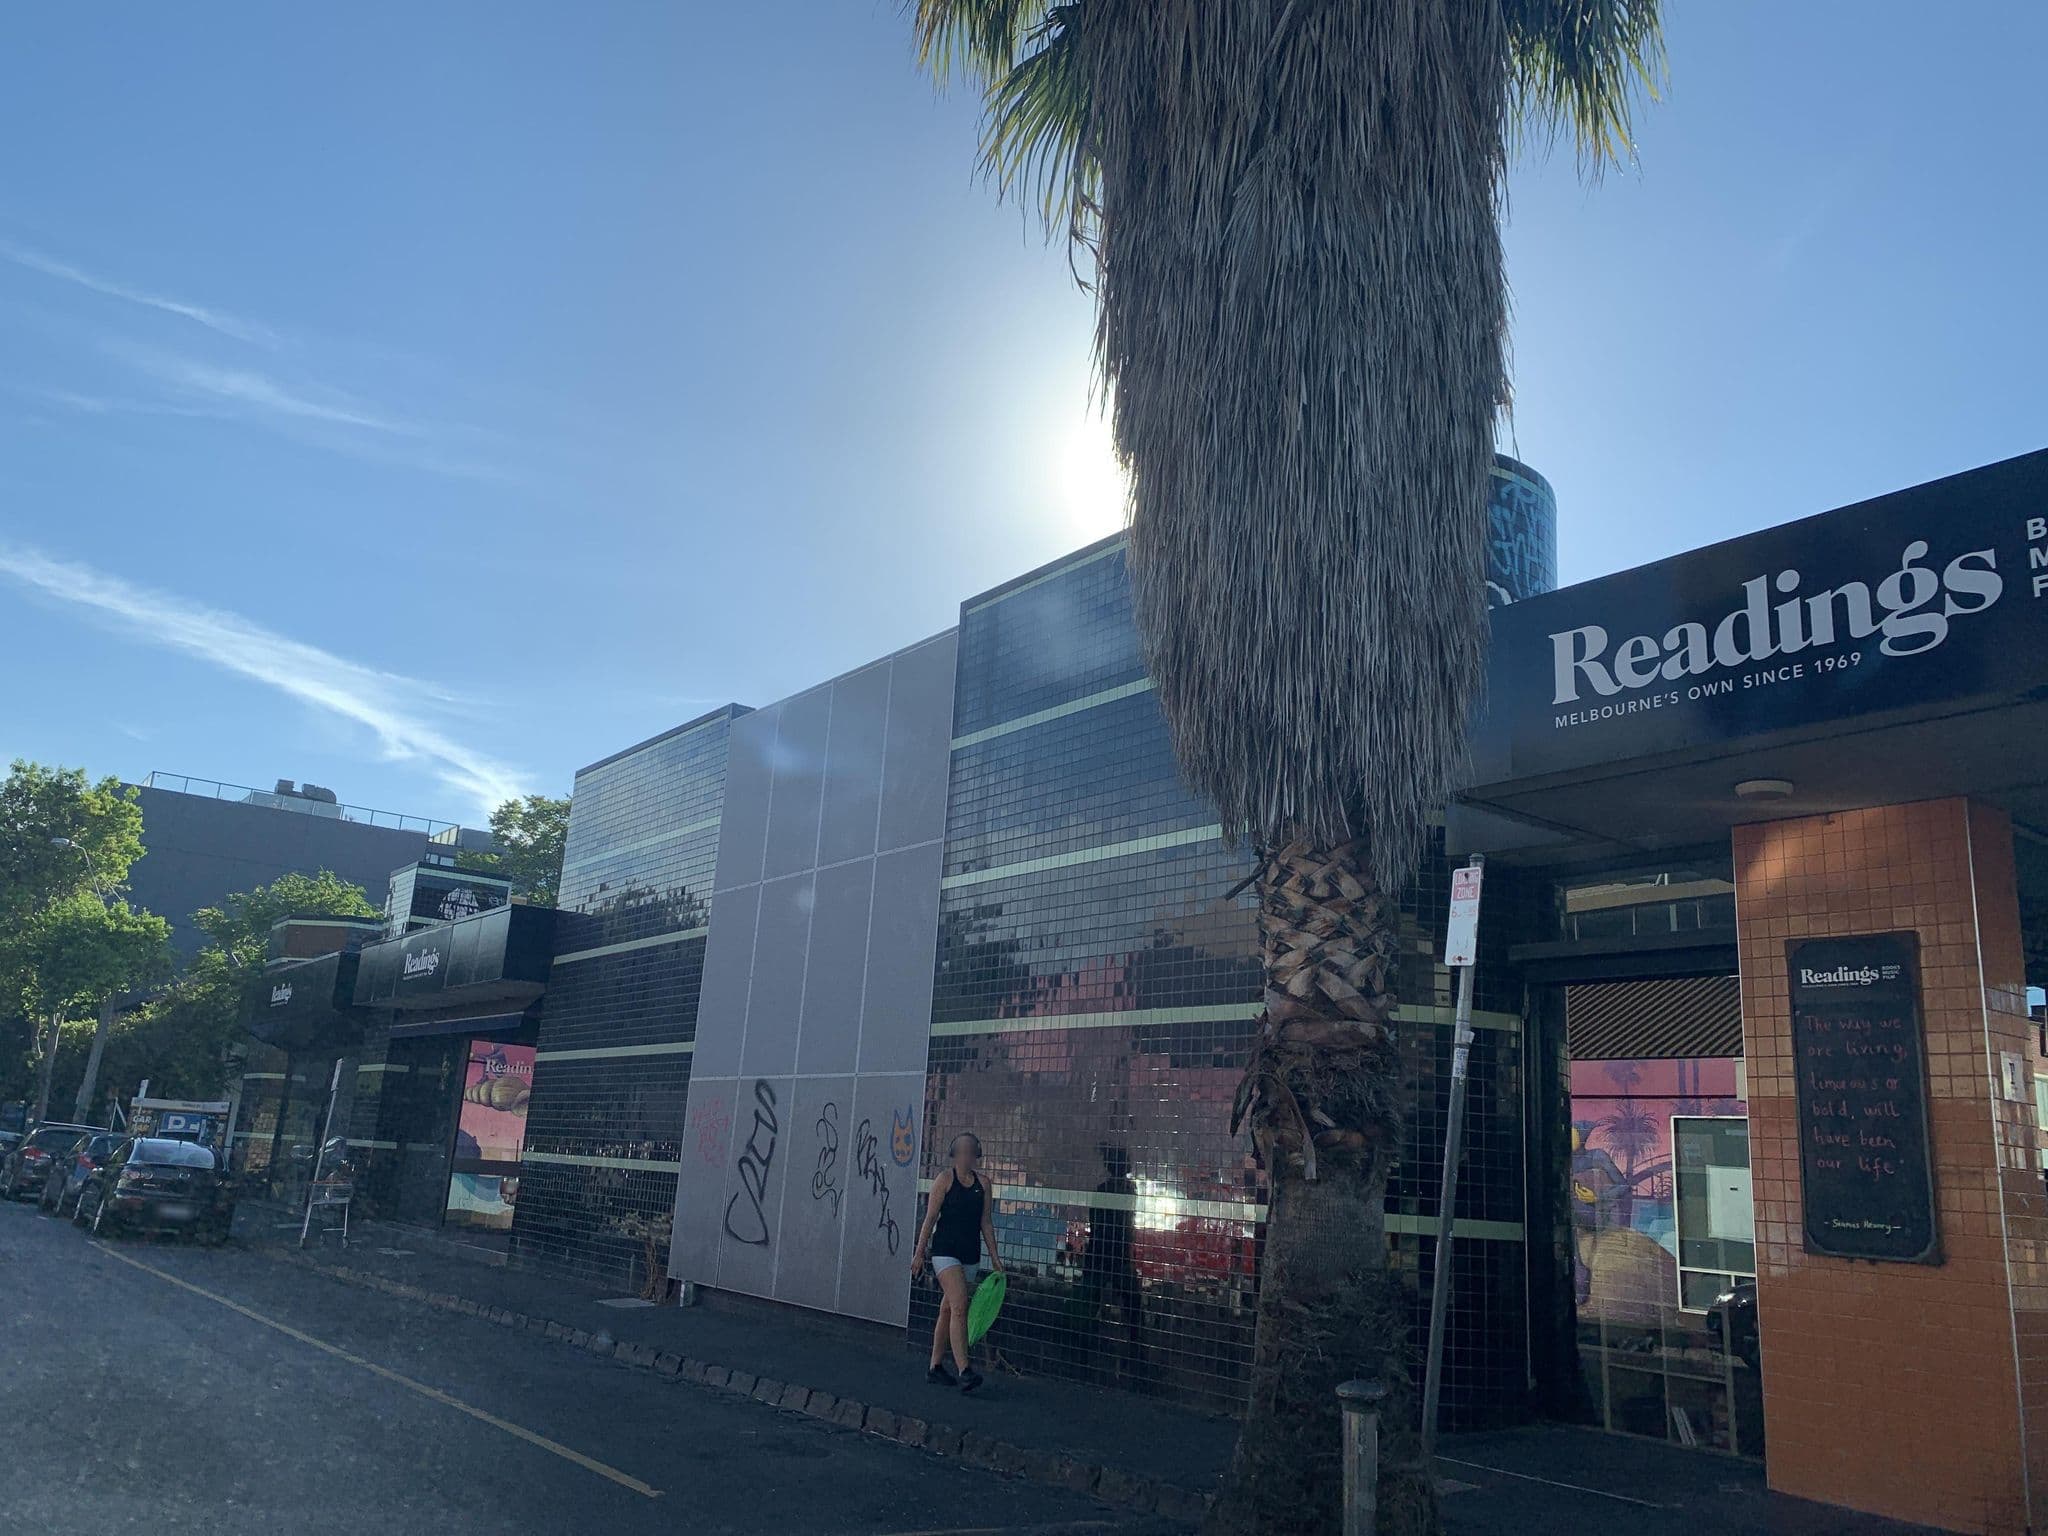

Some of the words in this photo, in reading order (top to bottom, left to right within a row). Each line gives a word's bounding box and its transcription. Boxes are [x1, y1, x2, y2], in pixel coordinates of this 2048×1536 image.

[1547, 540, 2003, 704] Readings
[1554, 691, 1679, 729] MELBOURNE'S
[1687, 678, 1734, 700] OWN
[1743, 664, 1804, 689] SINCE
[1814, 652, 1861, 674] 1969
[1456, 886, 1476, 899] ZONE
[404, 947, 440, 976] Readings
[1800, 965, 1880, 986] Readings
[1839, 1018, 1873, 1037] way
[1880, 1018, 1903, 1029] we
[1863, 1101, 1900, 1117] will
[1813, 1126, 1850, 1147] have
[1860, 1129, 1897, 1149] been
[1816, 1159, 1841, 1169] our
